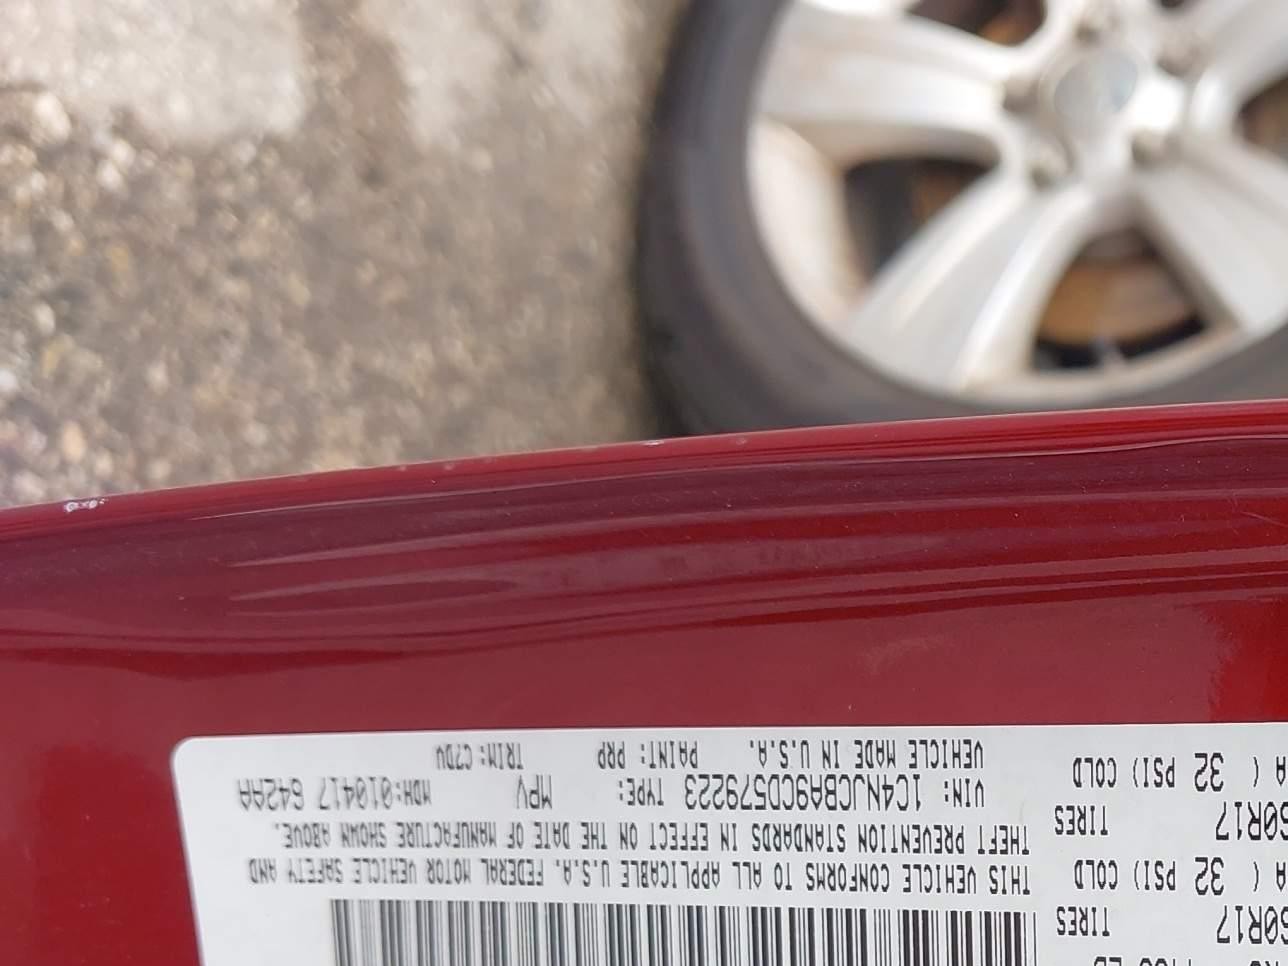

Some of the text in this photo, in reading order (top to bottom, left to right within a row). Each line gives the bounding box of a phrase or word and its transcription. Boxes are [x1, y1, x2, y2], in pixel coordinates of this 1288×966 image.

[480, 743, 524, 770] TRIM:
[598, 741, 625, 769] PRP
[641, 741, 698, 769] PAINT:
[750, 740, 810, 769] U.S.A.
[822, 740, 839, 769] IN
[854, 740, 896, 769] MADE
[908, 739, 983, 769] VEHICLE
[1073, 757, 1116, 788] COLD
[1133, 757, 1175, 788] PSI)
[1194, 753, 1224, 792] 32
[238, 778, 304, 811] 642AA
[517, 775, 552, 809] MPV
[619, 778, 664, 806] TYPE:
[685, 774, 921, 811] 1C4NJCBA9CD579223
[944, 778, 984, 807] VIN:
[1055, 805, 1108, 835] TIRES
[275, 821, 1029, 855] THEFT PREVENTION STANDARDS IN EFFECT ON THE DATE OF MANUFACTURE SHOWN ABOVE.
[249, 858, 1030, 895] THIS VEHICLE CONFORMS TO ALL APPLICABLE U.S.A. FEDERAL MOTOR VEHICLE SAFETY AND
[1074, 860, 1118, 890] COLD
[1134, 860, 1175, 891] PSI)
[1195, 857, 1224, 895] 32
[1057, 906, 1110, 937] TIRES
